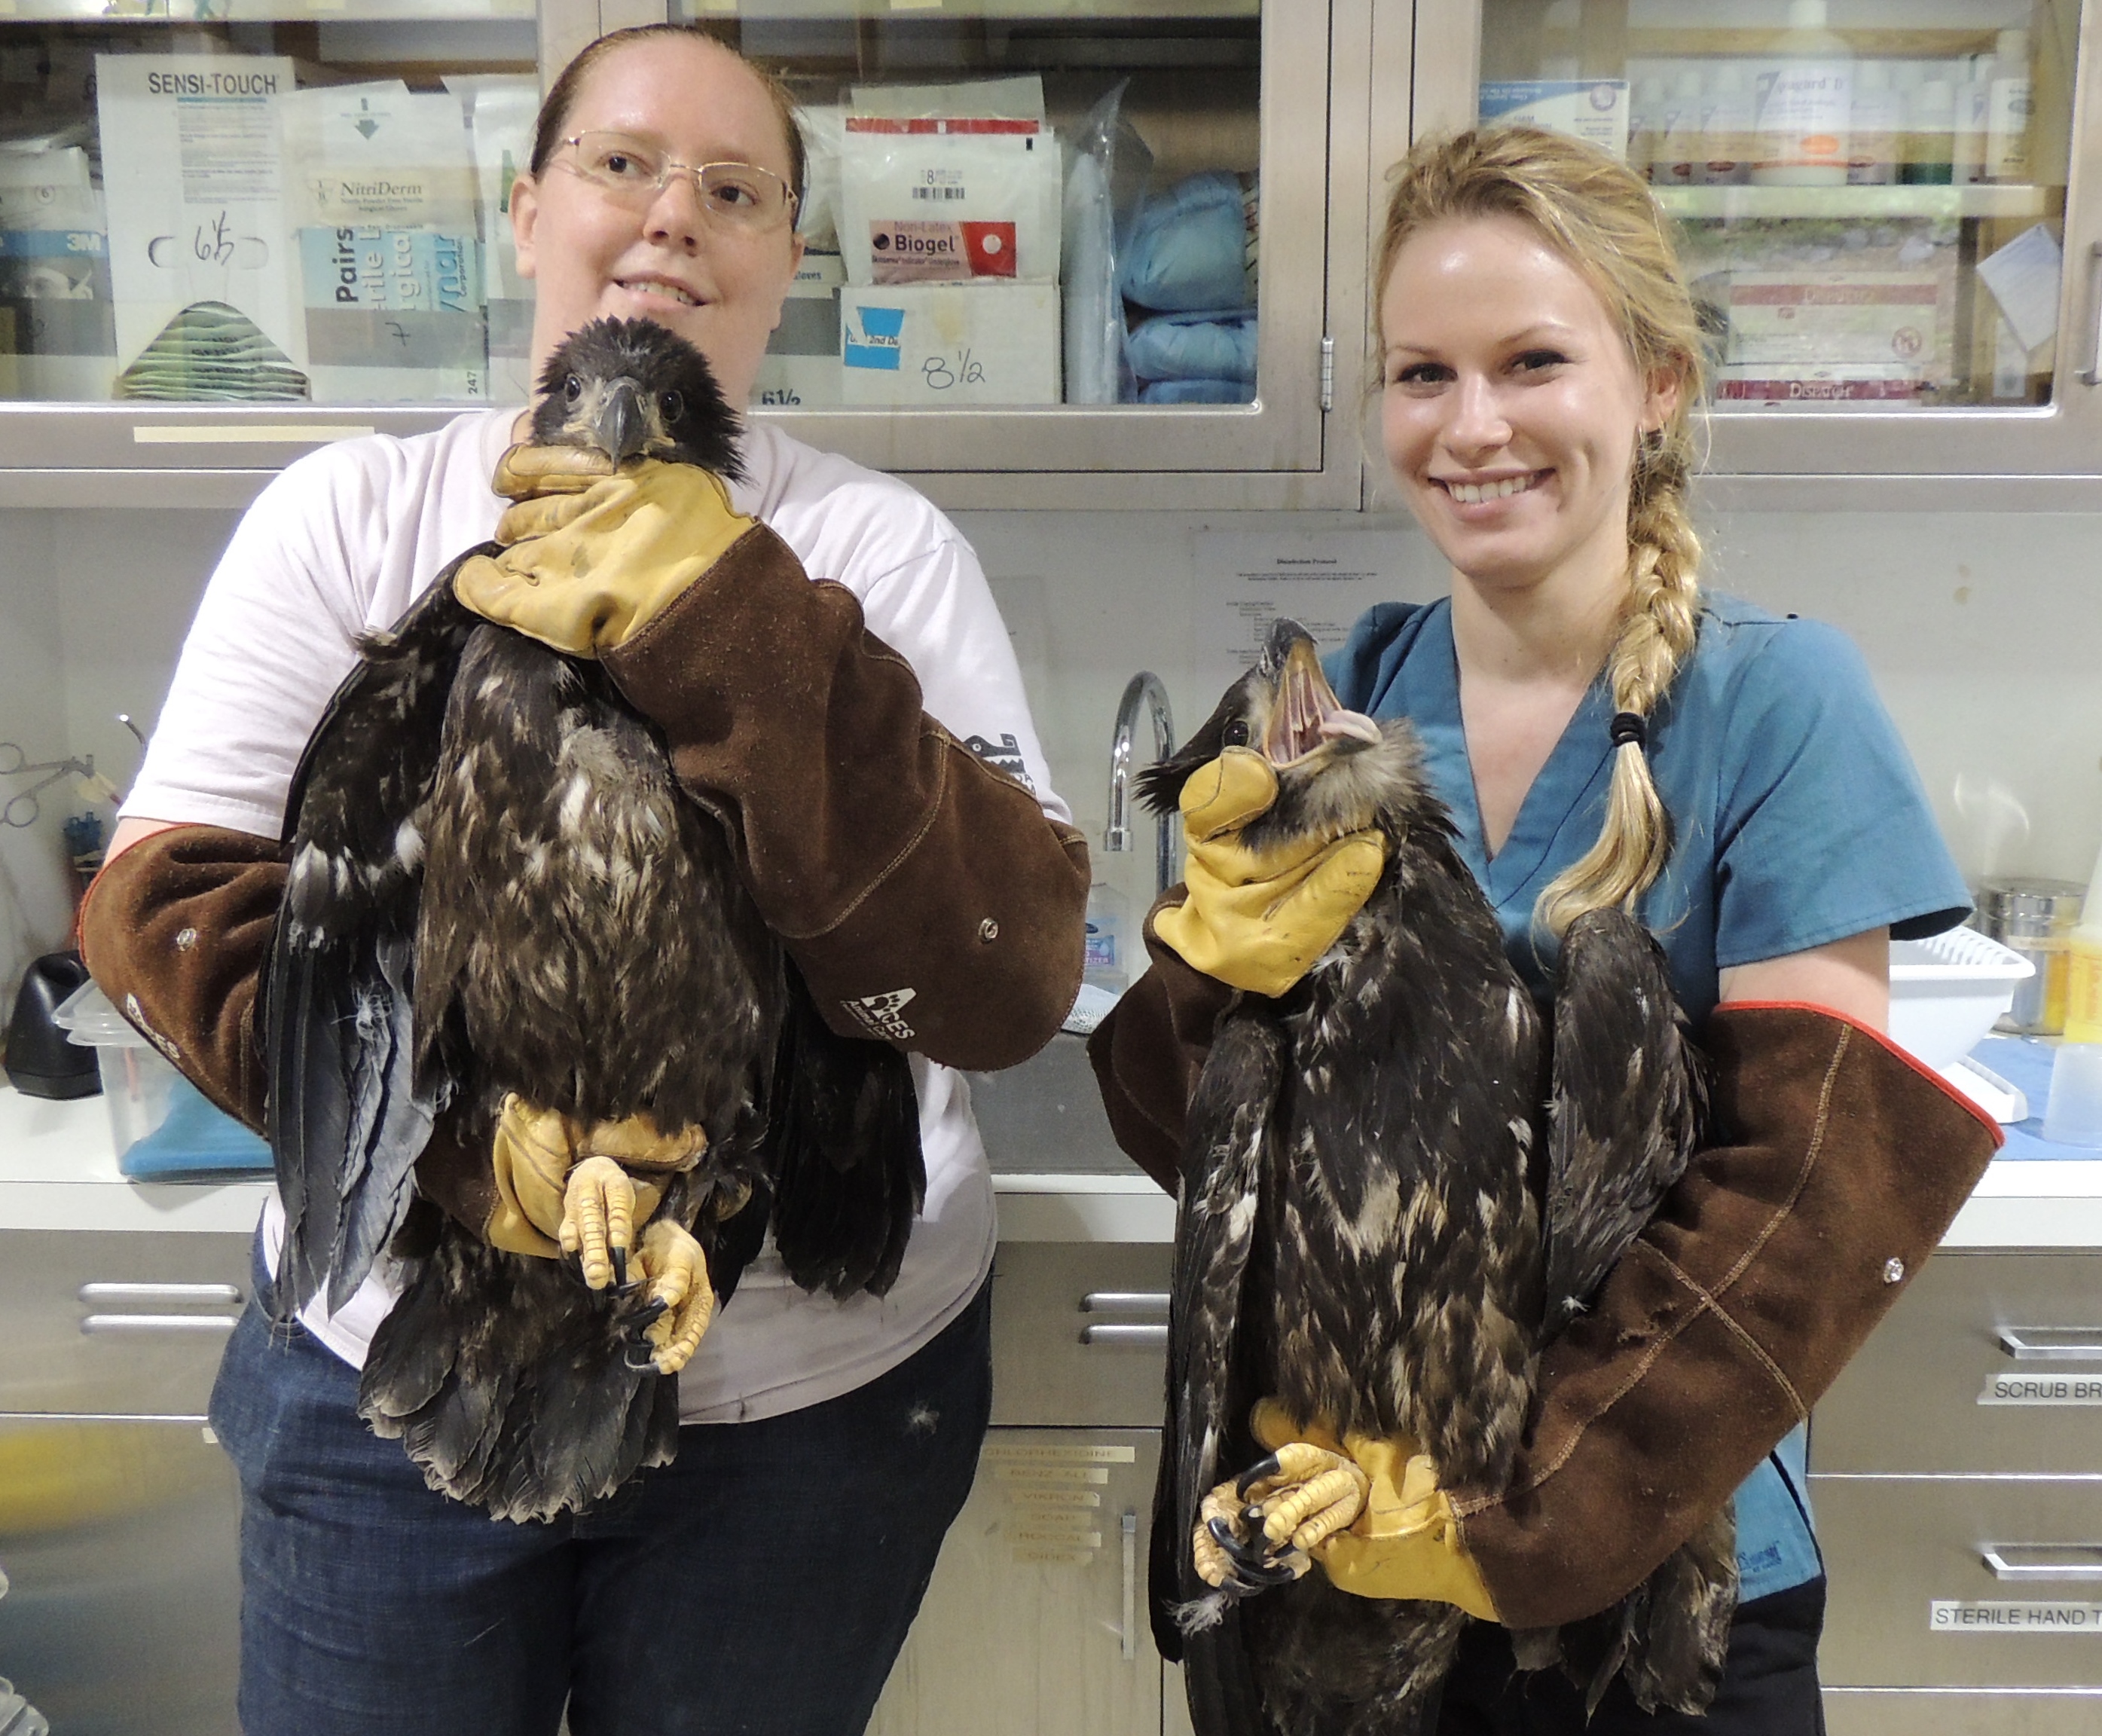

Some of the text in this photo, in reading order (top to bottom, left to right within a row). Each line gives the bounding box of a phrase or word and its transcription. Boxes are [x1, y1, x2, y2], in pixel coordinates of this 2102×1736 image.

[148, 72, 276, 94] SENSI-TOUCH
[341, 181, 423, 197] NitriDerm
[66, 233, 101, 251] 3M
[895, 234, 955, 255] Biogel
[332, 227, 359, 303] Pairs
[1995, 1382, 2102, 1398] SCRUB BR
[1935, 1609, 2021, 1624] STERILE
[2027, 1609, 2085, 1625] HAND
